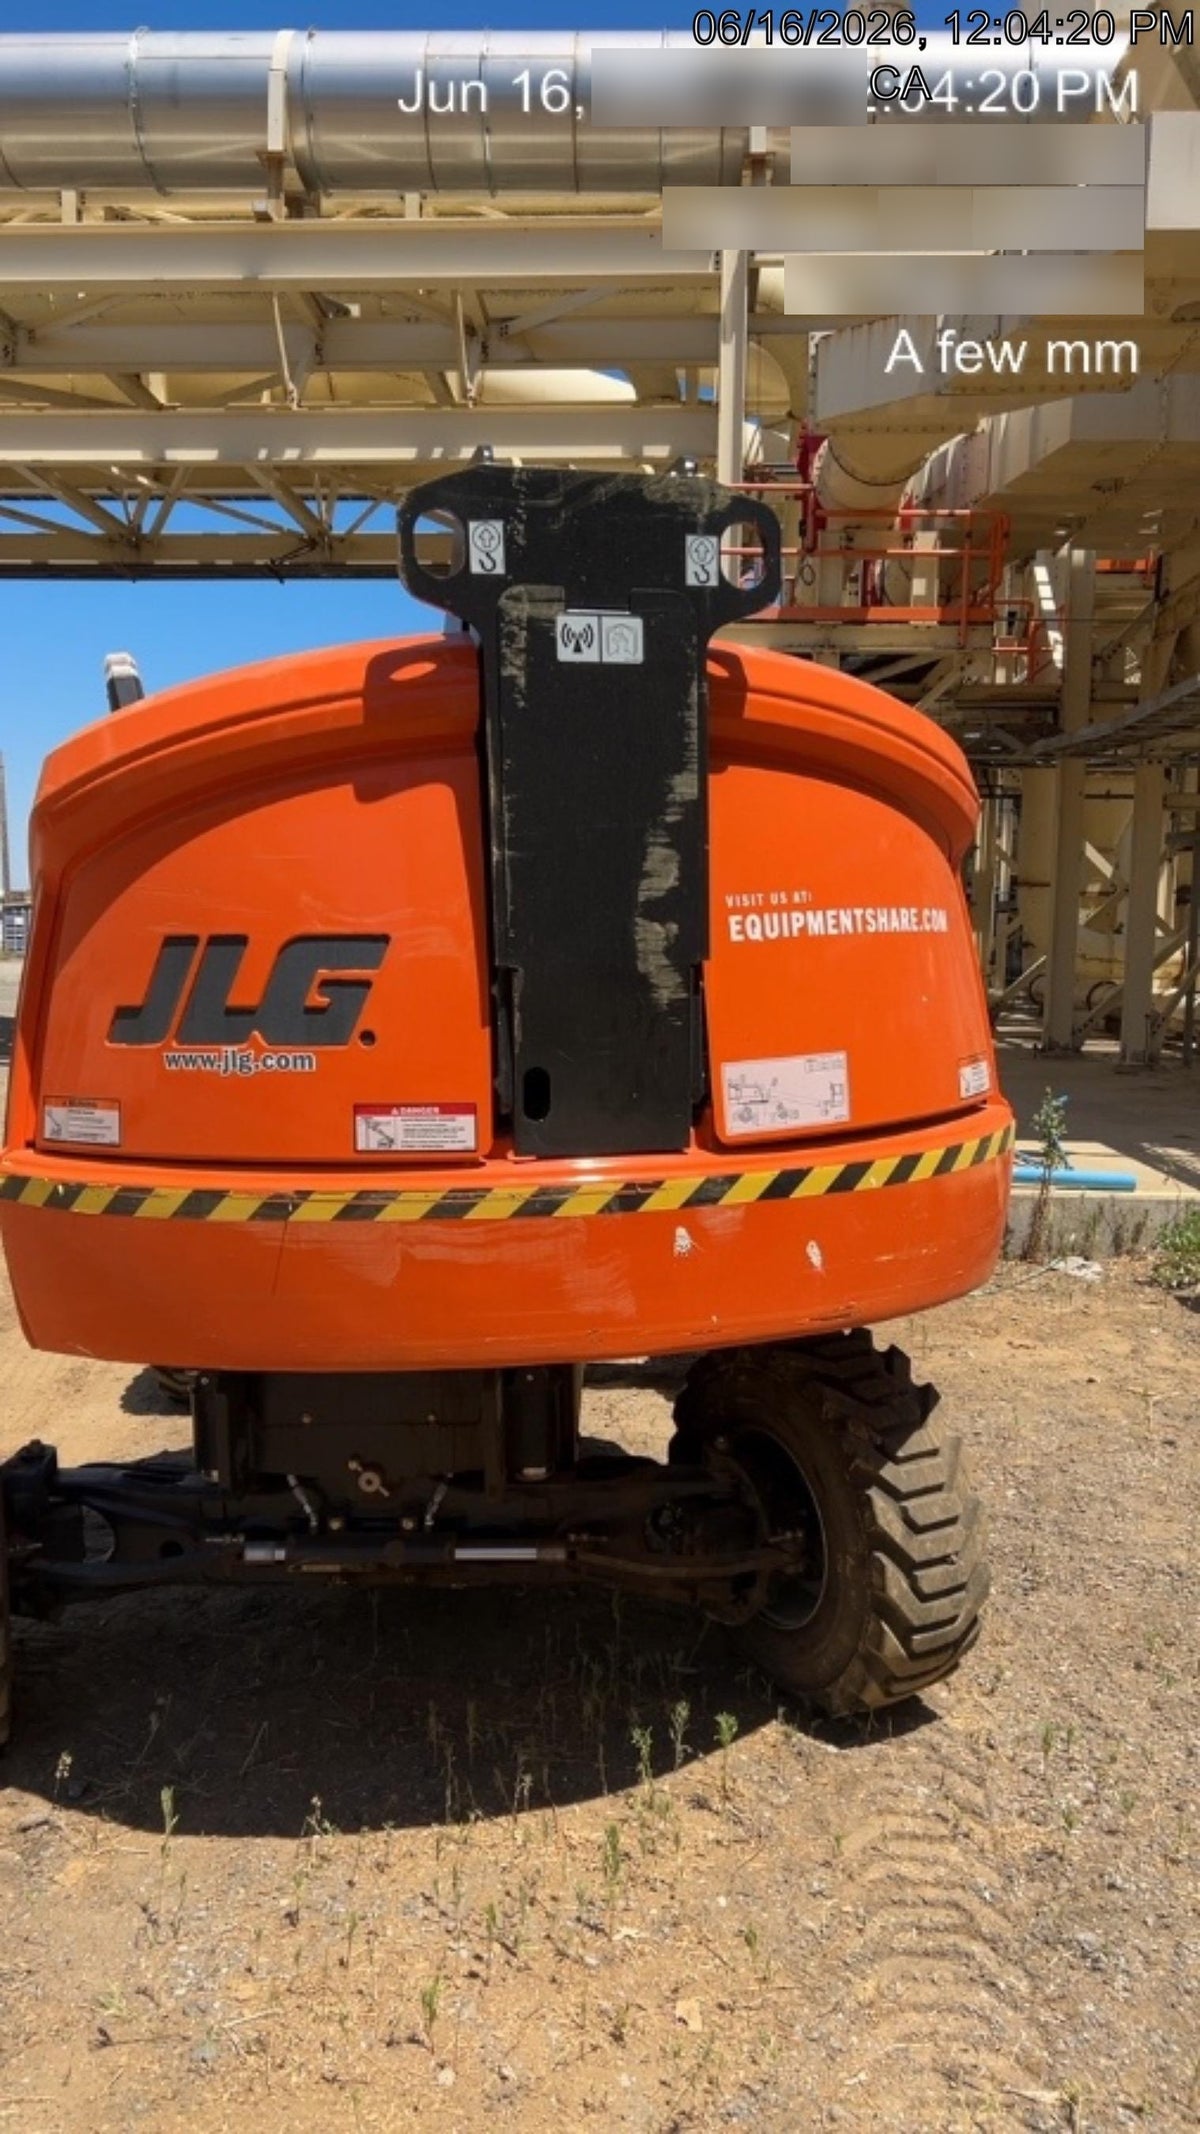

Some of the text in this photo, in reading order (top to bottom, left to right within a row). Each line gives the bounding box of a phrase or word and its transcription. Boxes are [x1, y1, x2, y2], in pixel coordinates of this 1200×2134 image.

[724, 892, 764, 909] VISIT
[769, 890, 789, 906] US
[727, 906, 949, 943] EQUIPMENTSHARE.COM
[105, 933, 392, 1046] JLG
[164, 1049, 315, 1076] www.jlg.com
